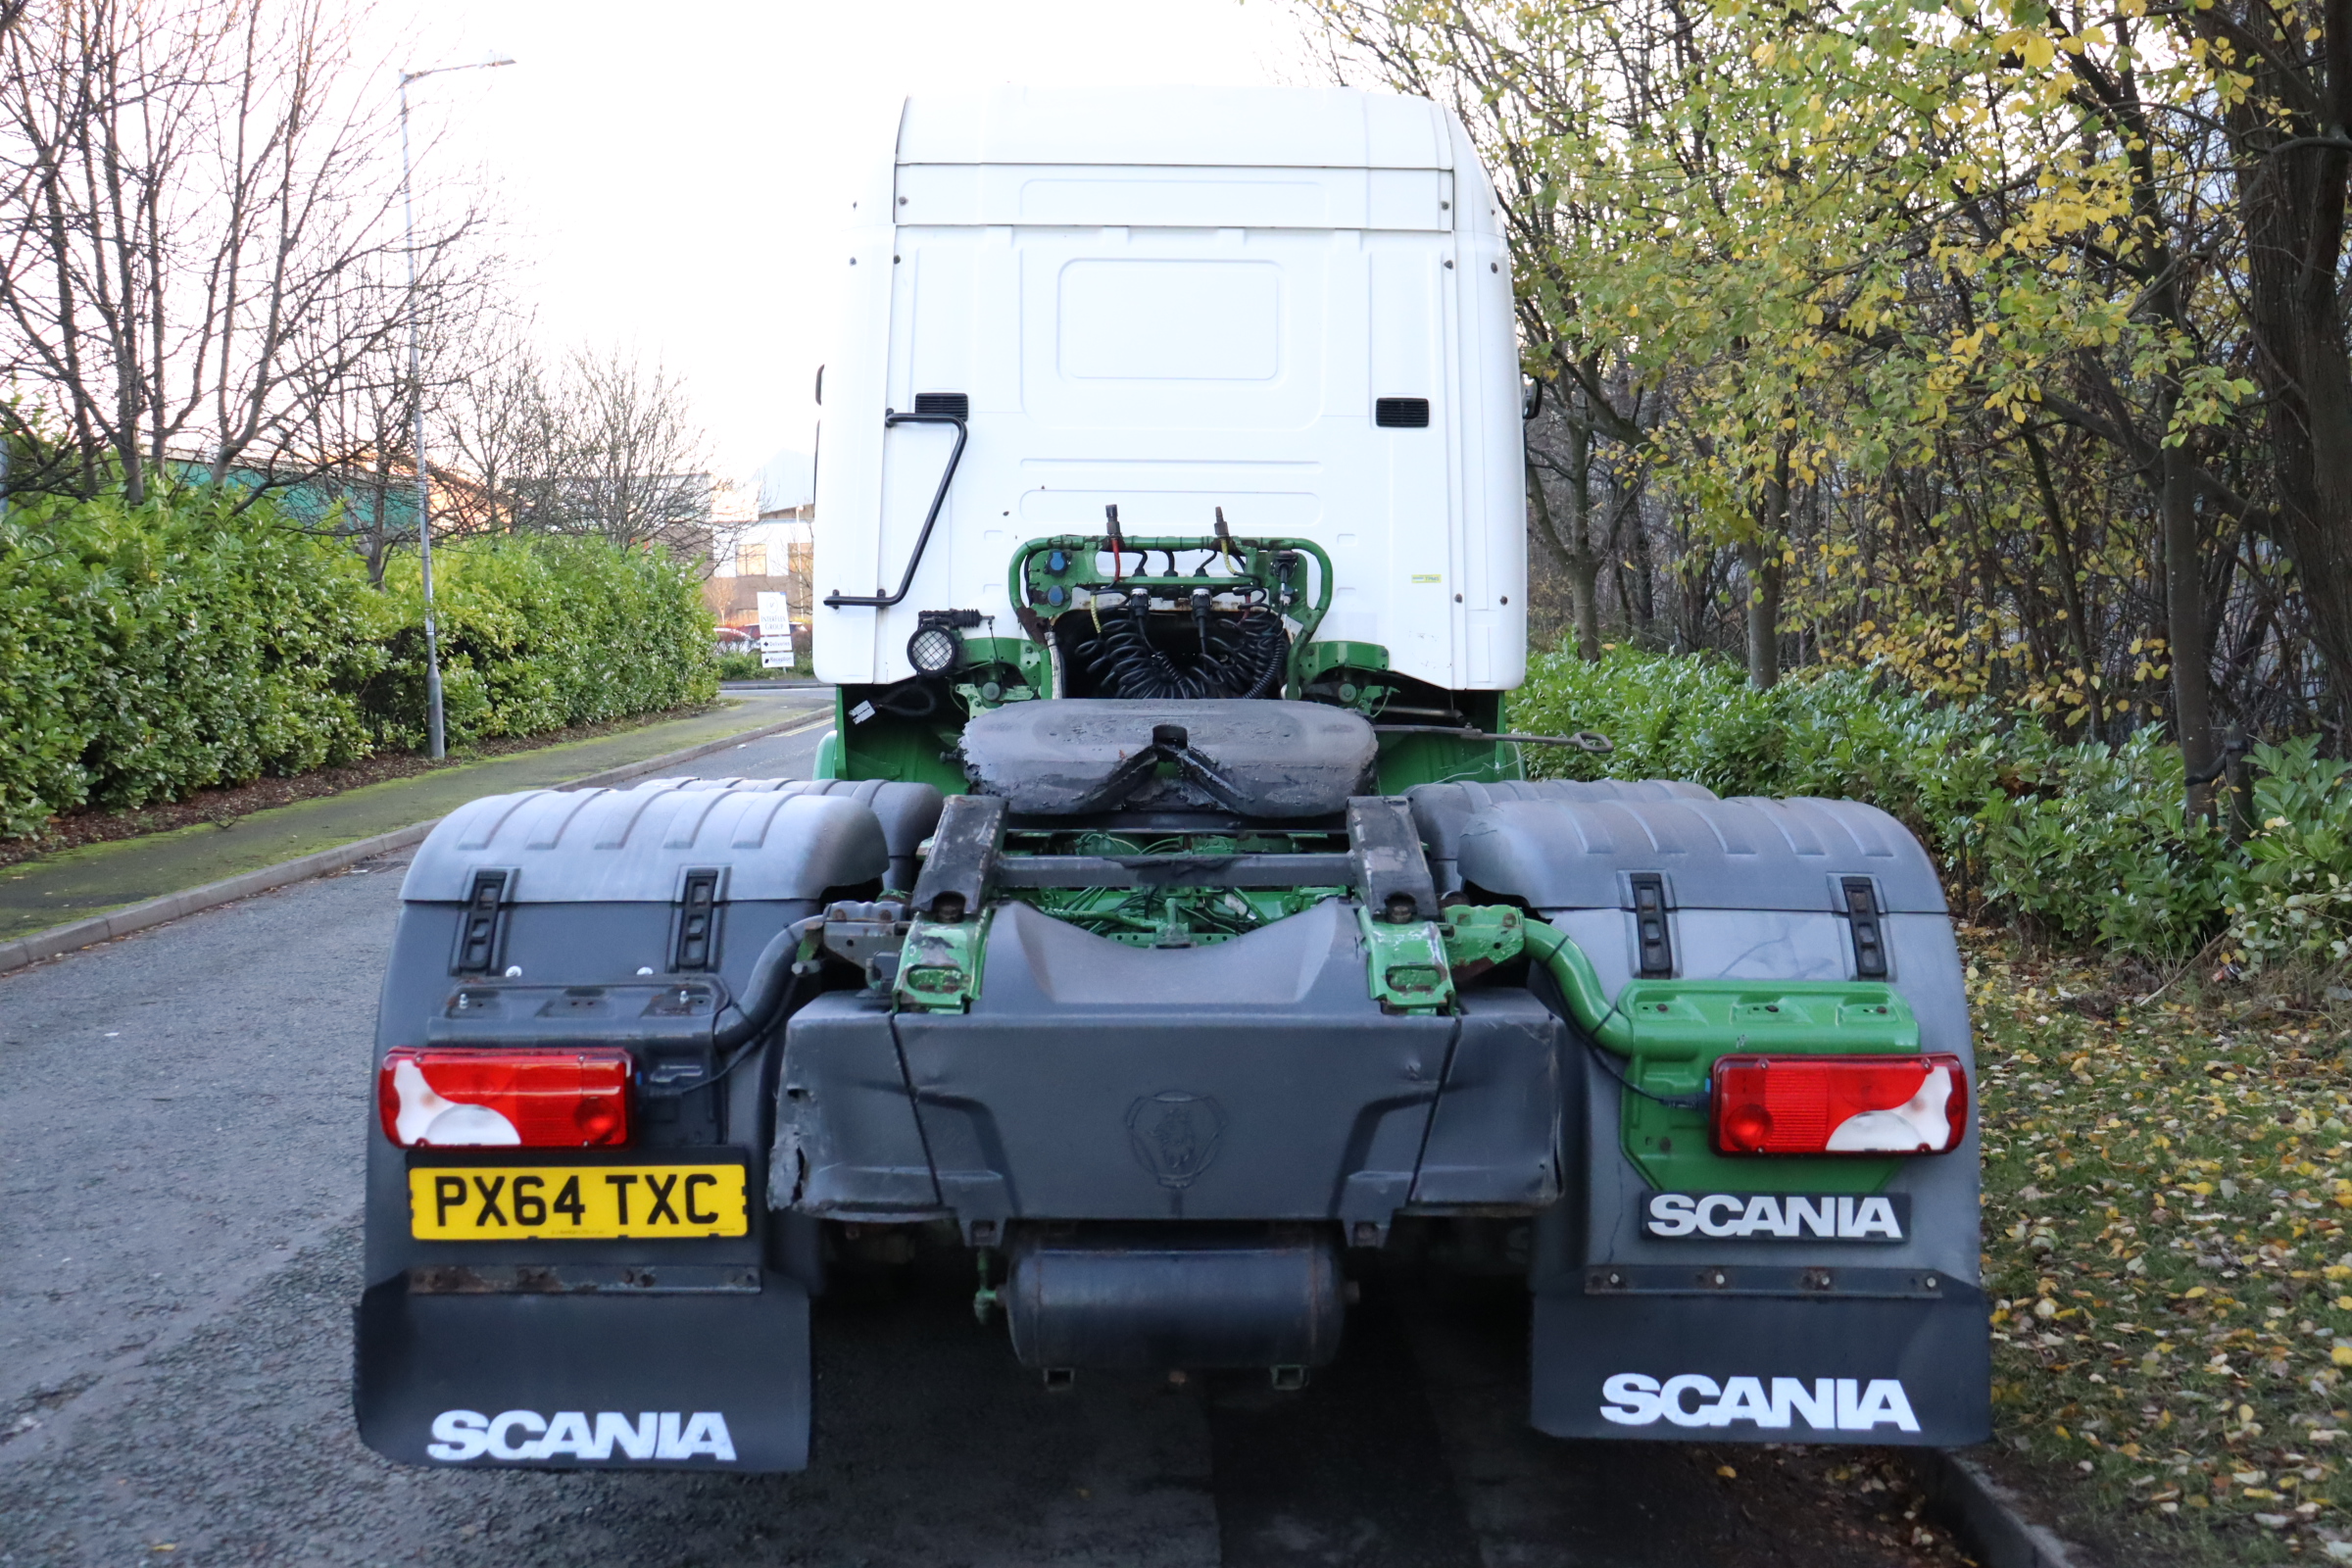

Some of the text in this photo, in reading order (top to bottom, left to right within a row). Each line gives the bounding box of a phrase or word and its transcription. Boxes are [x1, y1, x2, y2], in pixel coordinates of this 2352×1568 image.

[435, 1173, 719, 1226] PX64 TXC
[1647, 1194, 1902, 1239] SCANIA
[1599, 1372, 1921, 1432] SCANIA
[426, 1409, 737, 1461] SCANIA
